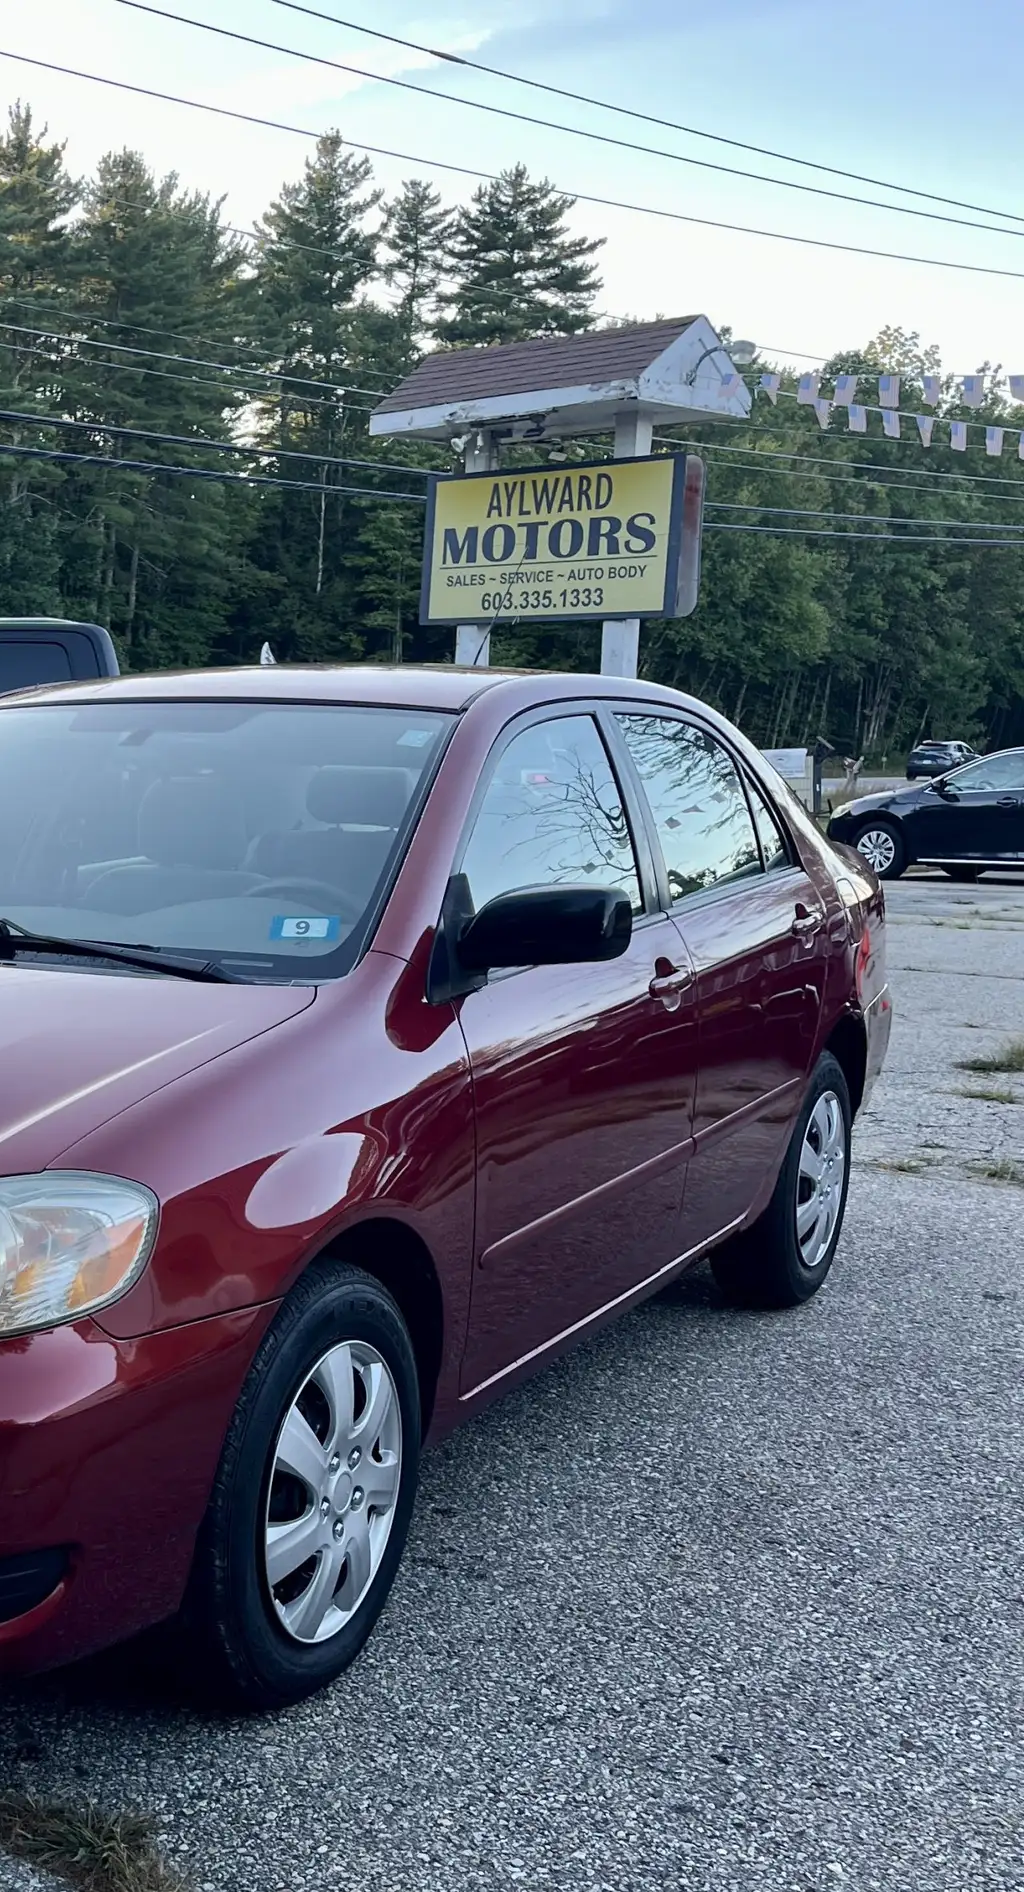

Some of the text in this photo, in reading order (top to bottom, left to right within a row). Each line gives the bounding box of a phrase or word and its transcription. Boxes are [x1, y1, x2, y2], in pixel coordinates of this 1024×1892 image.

[486, 473, 613, 518] AYLWARD
[442, 512, 656, 565] MOTORS
[446, 573, 486, 588] SALES
[499, 570, 554, 585] SERVICE
[567, 567, 604, 581] AUTO
[608, 564, 647, 579] BODY
[481, 587, 604, 611] 603.335.1333
[295, 920, 311, 936] 9
